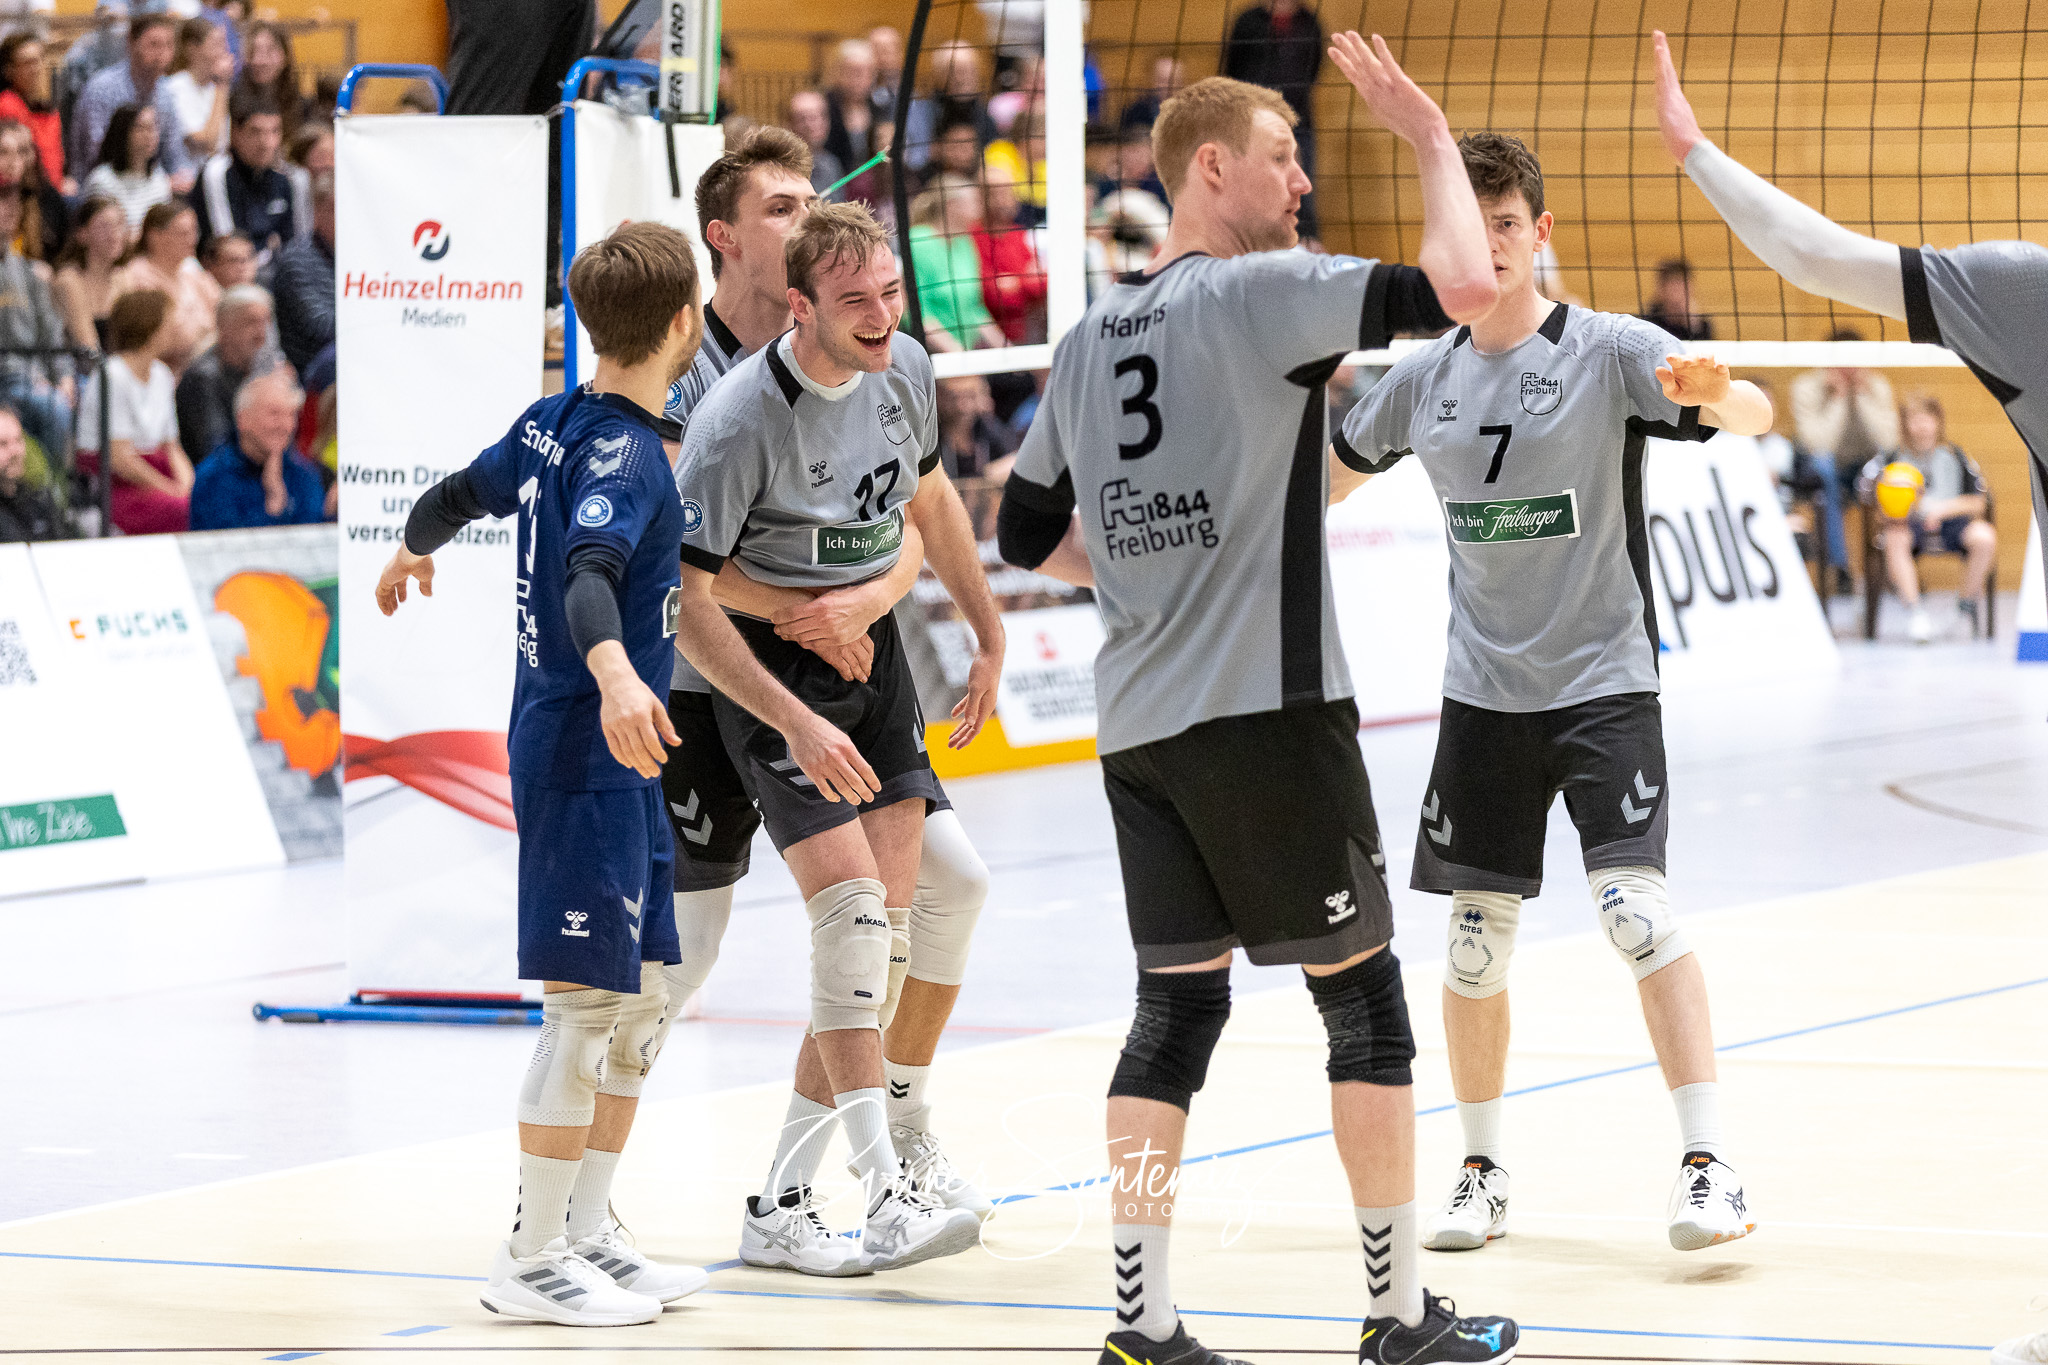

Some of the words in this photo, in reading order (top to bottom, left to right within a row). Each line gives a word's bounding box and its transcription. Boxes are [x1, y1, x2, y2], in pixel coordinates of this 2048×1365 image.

[344, 272, 523, 300] Heinzelmann
[401, 307, 467, 327] Medien
[1520, 386, 1558, 396] Freiburg
[1538, 377, 1559, 387] 1844
[1114, 353, 1163, 461] 3
[1479, 424, 1512, 484] 7
[341, 463, 405, 485] Wenn
[854, 458, 901, 522] 17
[1148, 489, 1211, 522] 1844
[1466, 515, 1485, 528] bin
[1478, 504, 1563, 540] Freiburger
[826, 536, 846, 549] Ich
[852, 537, 872, 550] bin
[1105, 517, 1220, 561] Freiburg
